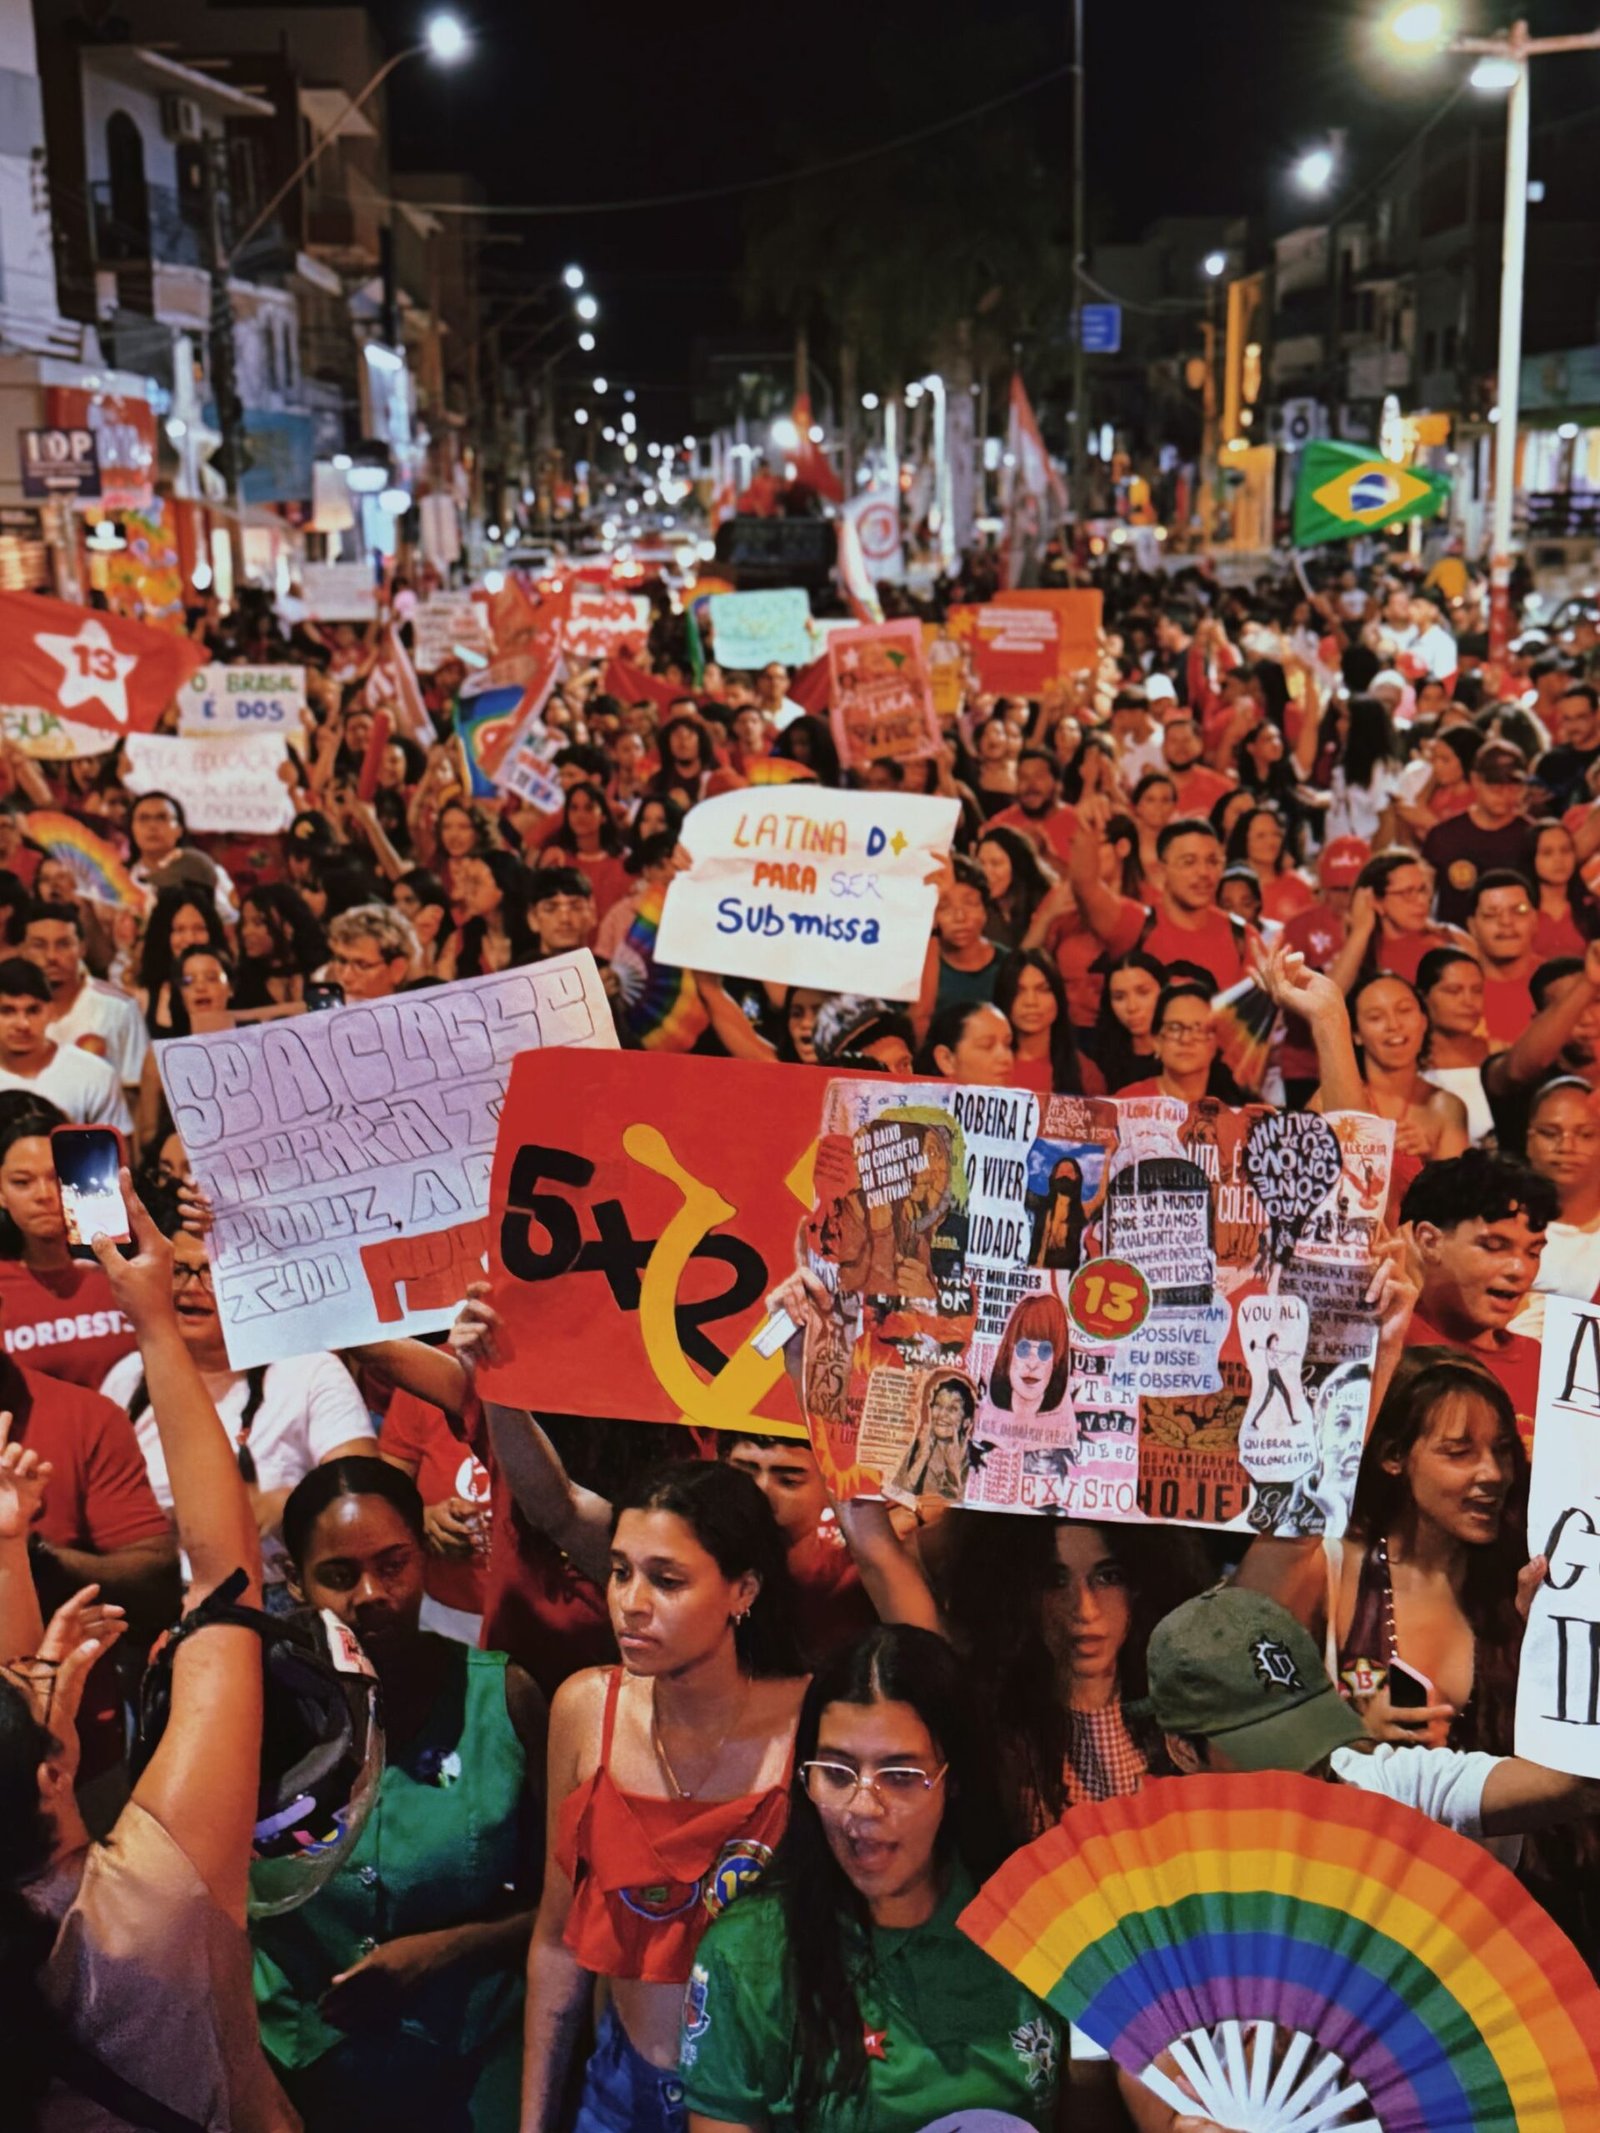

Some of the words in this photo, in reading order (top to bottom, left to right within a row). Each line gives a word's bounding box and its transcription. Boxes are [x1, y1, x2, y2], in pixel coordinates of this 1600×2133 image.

[72, 644, 118, 681] 13
[191, 674, 207, 692] O
[237, 701, 284, 721] DOS
[734, 814, 847, 855] LATINA
[753, 861, 817, 894] PARA
[830, 871, 883, 900] SER
[164, 1041, 262, 1148] SE
[262, 1028, 332, 1123] A
[330, 965, 595, 1102] CLASSE
[1024, 1093, 1035, 1143] É
[873, 1124, 901, 1148] BAIXO
[1247, 1112, 1328, 1156] GALINHA
[1279, 1134, 1299, 1149] DA
[858, 1154, 871, 1173] DO
[872, 1137, 919, 1170] CONCRETO
[1232, 1139, 1242, 1183] É
[1248, 1148, 1297, 1176] OVO
[1310, 1147, 1337, 1160] NO
[876, 1162, 906, 1187] TERRA
[907, 1153, 930, 1178] PARA
[981, 1156, 1025, 1203] VIVER
[1297, 1157, 1340, 1184] COM
[409, 1169, 460, 1222] A
[1113, 1197, 1138, 1213] POR
[1163, 1193, 1204, 1211] MUNDO
[1253, 1175, 1327, 1205] CONTE
[1266, 1199, 1310, 1222] NÃO
[221, 1252, 350, 1324] TUDO
[986, 1269, 1042, 1290] MULHERES
[1301, 1279, 1330, 1293] QUEM
[1085, 1276, 1138, 1321] 13
[1242, 1306, 1272, 1323] VOU
[816, 1347, 846, 1364] QUE
[1130, 1350, 1150, 1365] EU
[1112, 1373, 1136, 1387] ME
[1140, 1372, 1213, 1389] OBSERVE
[1244, 1438, 1293, 1450] QUEBRAR
[1021, 1476, 1135, 1514] EXISTO
[1355, 1670, 1373, 1689] 13
